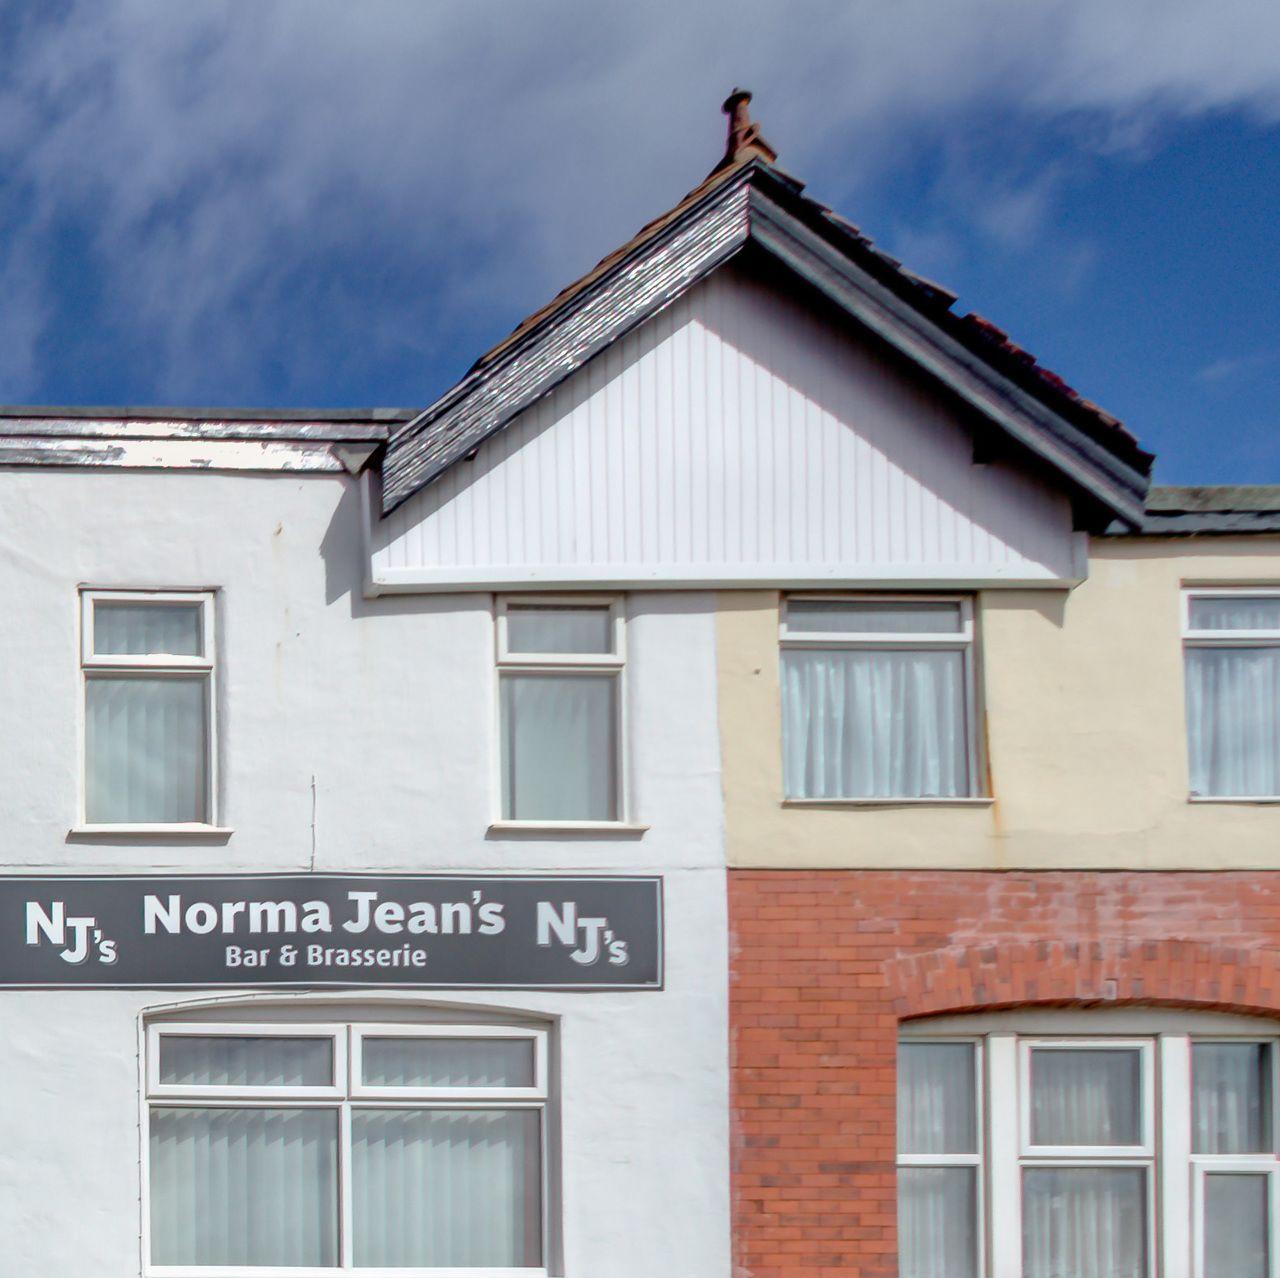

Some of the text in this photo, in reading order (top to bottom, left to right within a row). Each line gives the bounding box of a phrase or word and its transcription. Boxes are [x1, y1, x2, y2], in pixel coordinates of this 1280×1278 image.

[25, 900, 119, 966] NJ's
[143, 889, 507, 936] Norma Jean's
[536, 900, 631, 967] NJ's
[225, 942, 427, 968] Bar & Brasserie
